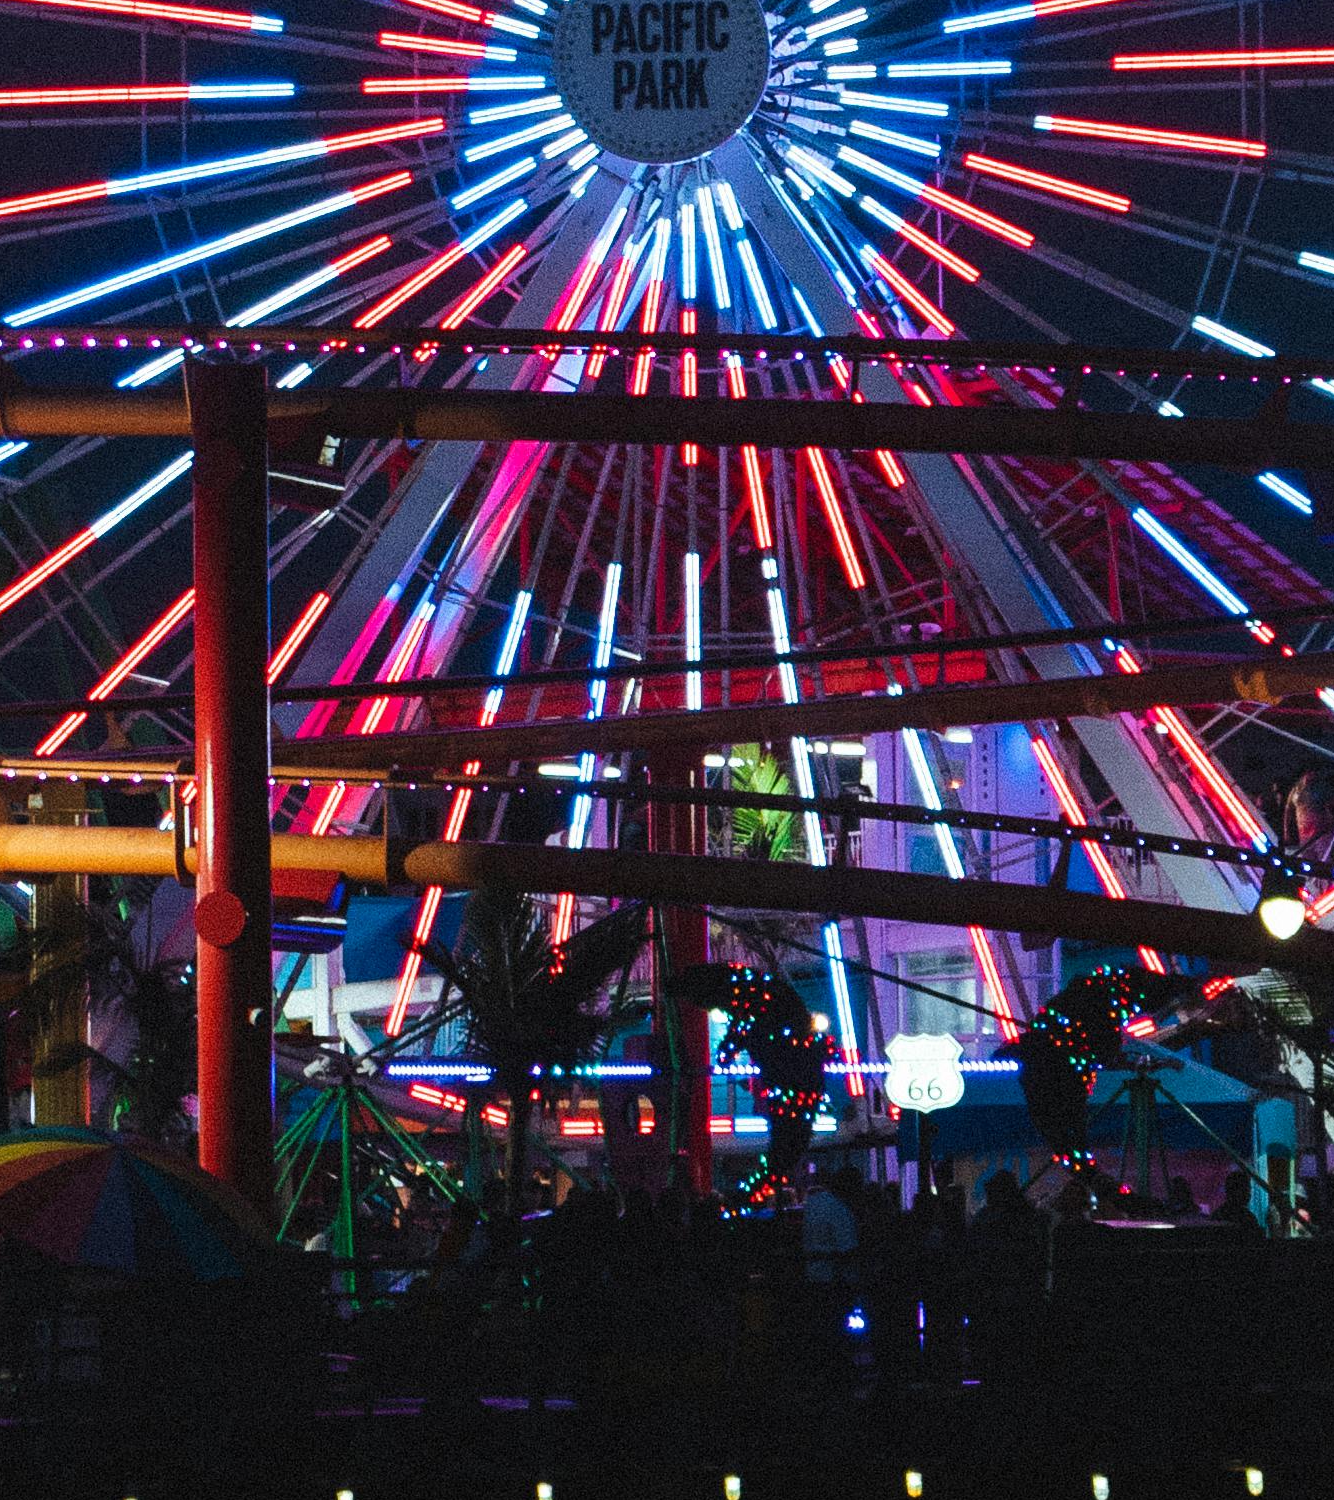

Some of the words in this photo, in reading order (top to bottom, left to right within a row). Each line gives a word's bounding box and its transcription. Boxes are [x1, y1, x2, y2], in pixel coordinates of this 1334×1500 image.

[592, 1, 730, 54] PACIFIC
[613, 58, 709, 110] PARK
[908, 1077, 943, 1101] 66
